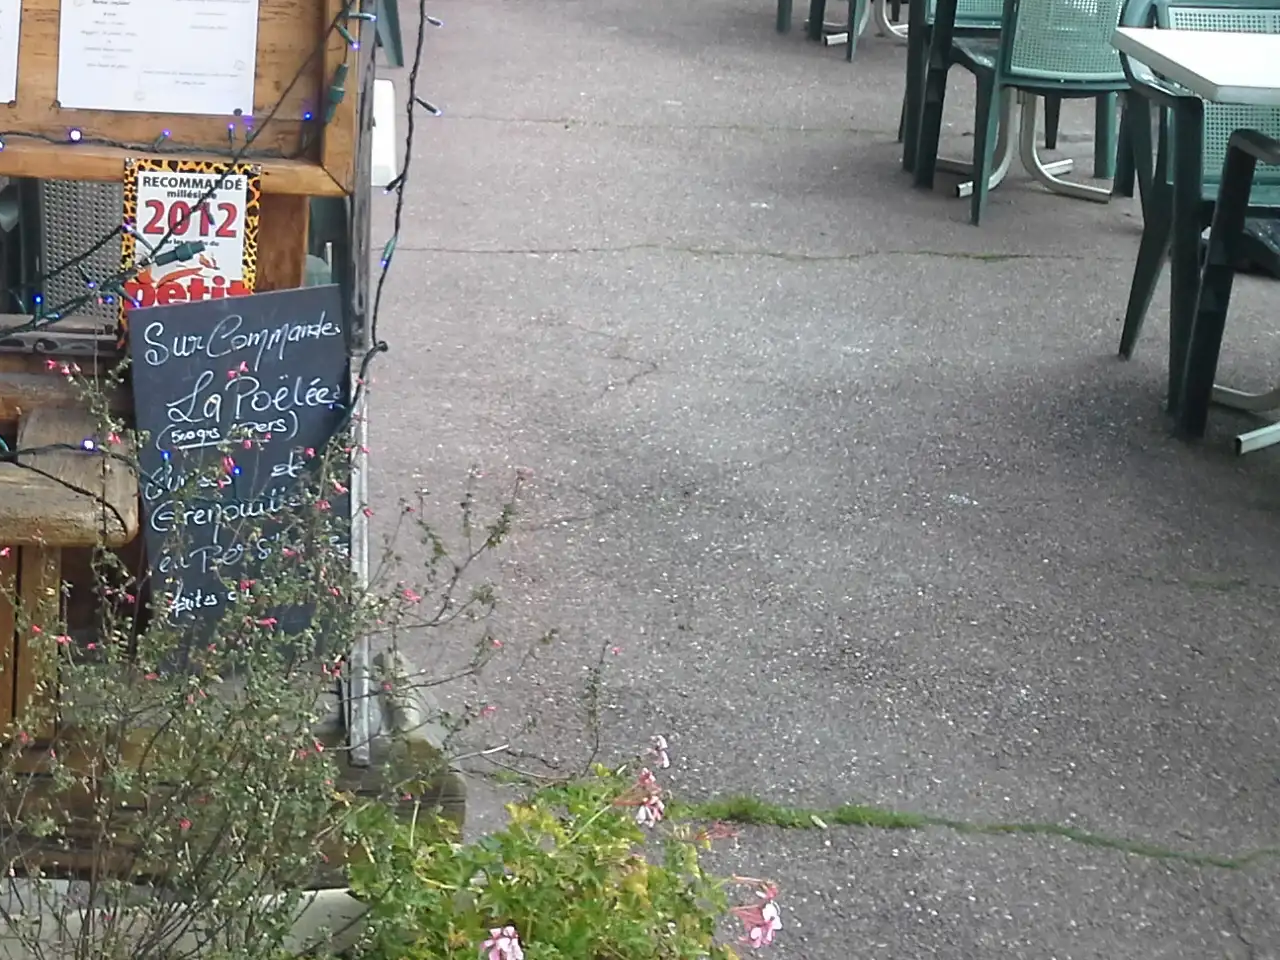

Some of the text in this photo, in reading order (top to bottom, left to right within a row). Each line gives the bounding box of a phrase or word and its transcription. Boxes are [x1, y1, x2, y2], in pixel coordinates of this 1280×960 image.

[143, 200, 238, 238] 2012
[144, 322, 203, 366] Sur
[166, 370, 222, 424] La
